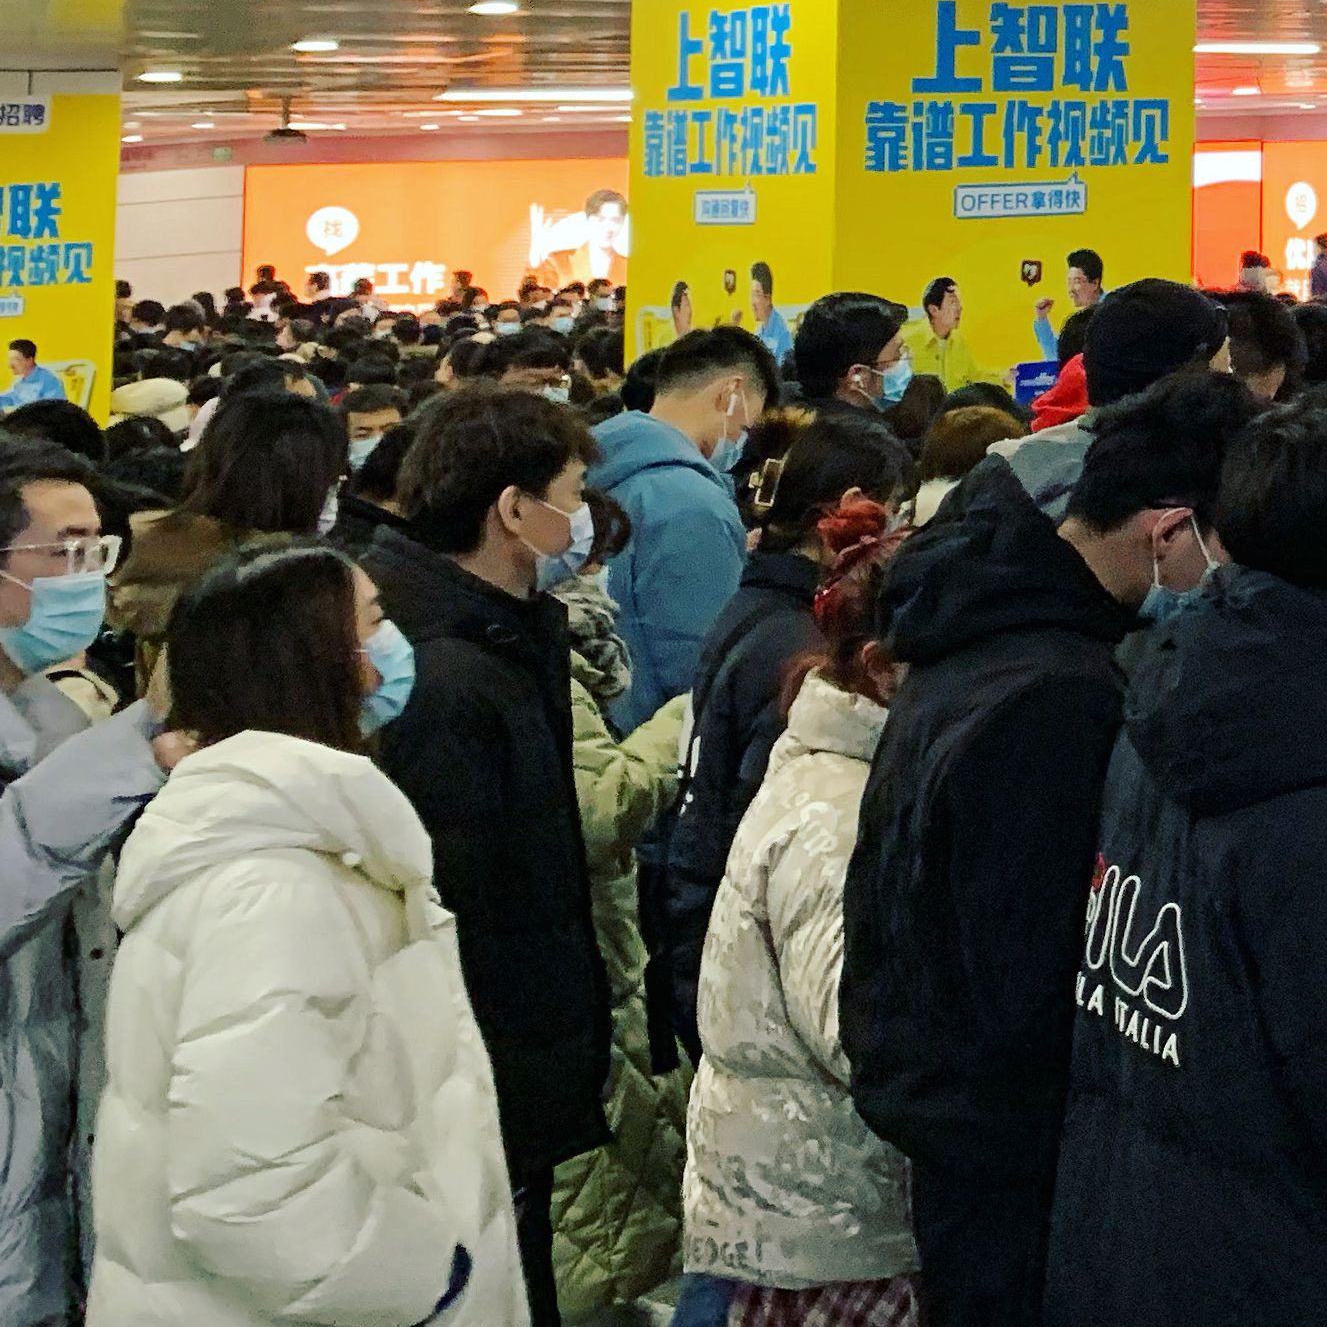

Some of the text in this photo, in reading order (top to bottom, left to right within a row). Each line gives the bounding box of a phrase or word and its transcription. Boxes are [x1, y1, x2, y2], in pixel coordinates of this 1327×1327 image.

[667, 1, 792, 101] 上智联
[912, 0, 1130, 93] 上智联
[644, 102, 817, 177] 靠谱工作视频见
[865, 99, 1169, 172] 靠谱工作视频见
[0, 182, 62, 239] 联
[1115, 996, 1181, 1068] ITALIA
